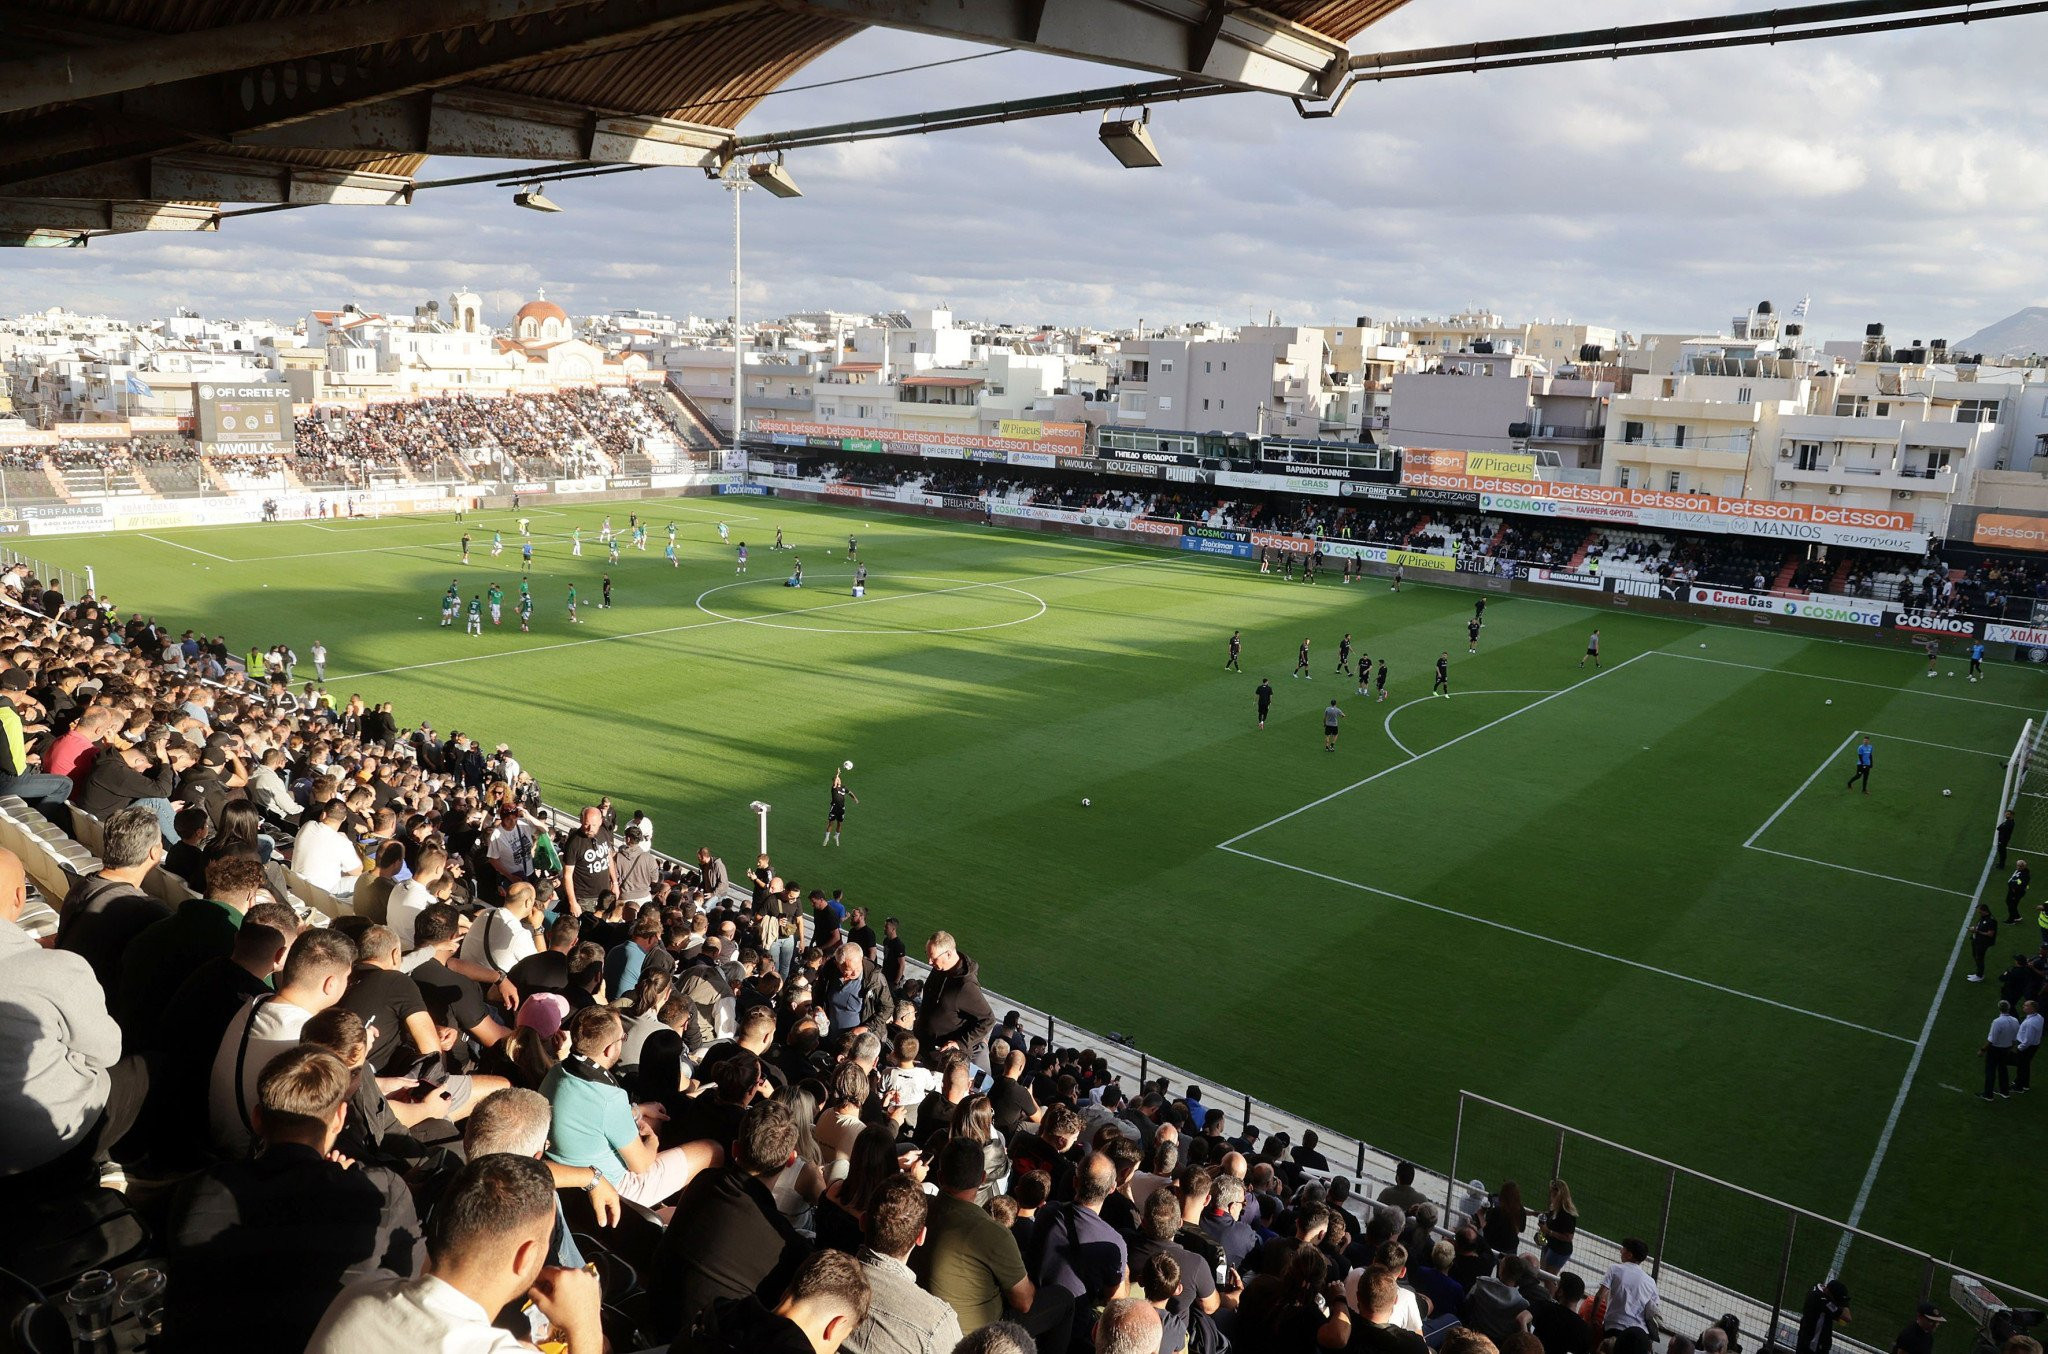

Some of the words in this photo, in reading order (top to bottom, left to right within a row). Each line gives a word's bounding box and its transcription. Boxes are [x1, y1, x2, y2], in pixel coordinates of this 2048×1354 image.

[216, 388, 235, 398] OFI
[238, 388, 274, 398] CRETE
[275, 388, 291, 398] FC
[60, 424, 122, 436] betsson
[757, 420, 789, 432] betsson
[791, 422, 824, 434] betsson
[826, 425, 861, 437] betsson
[1011, 423, 1040, 436] Piraeus
[1043, 424, 1081, 437] betsson
[863, 427, 900, 440] betsson
[903, 430, 940, 443] betsson
[944, 433, 983, 447] betsson
[215, 442, 274, 455] VAVOULAS
[987, 437, 1029, 451] betsson
[1033, 440, 1078, 455] betsson
[938, 448, 954, 456] CRETE
[1115, 450, 1140, 460] ΓΗΠΕΔΟ
[1142, 453, 1178, 463] ΘΕΟΔΩΡΟΣ
[1063, 459, 1093, 470] VAVOULAS
[1405, 453, 1459, 467] betsson
[1485, 458, 1532, 473] Piraeus
[1106, 461, 1158, 475] KOUZEINERI
[1301, 480, 1329, 489] GRASS
[1402, 470, 1468, 488] betsson
[724, 484, 763, 495] Stoiximan
[1473, 476, 1543, 496] betsson
[1549, 483, 1624, 504] betsson
[203, 497, 247, 508] TOYOTA
[944, 498, 964, 508] STELLA
[965, 500, 986, 511] HOTELS
[1495, 497, 1556, 513] COSMOTE
[1631, 490, 1710, 511] betsson
[39, 505, 102, 517] ORFANAKIS
[994, 505, 1031, 516] COSMOTE
[1717, 498, 1802, 520] betsson
[143, 516, 182, 527] Piraeus
[1811, 505, 1904, 530] betsson
[1129, 519, 1179, 536] betsson
[1753, 521, 1822, 540] MANIOS
[1976, 524, 2044, 541] betsson
[1197, 529, 1235, 540] COSMOTE
[1235, 533, 1246, 542] TV
[1251, 532, 1309, 552] betsson
[1200, 538, 1234, 550] Stoiximan
[1334, 544, 1387, 560] COSMOTE
[1408, 555, 1446, 569] Piraeus
[1550, 573, 1579, 583] MINOAN
[1579, 575, 1600, 585] LINES
[1614, 579, 1661, 600] PUMA
[1713, 590, 1773, 609] CretaGas
[1802, 605, 1880, 626] COSMOTE
[1895, 613, 1974, 634] COSMOS
